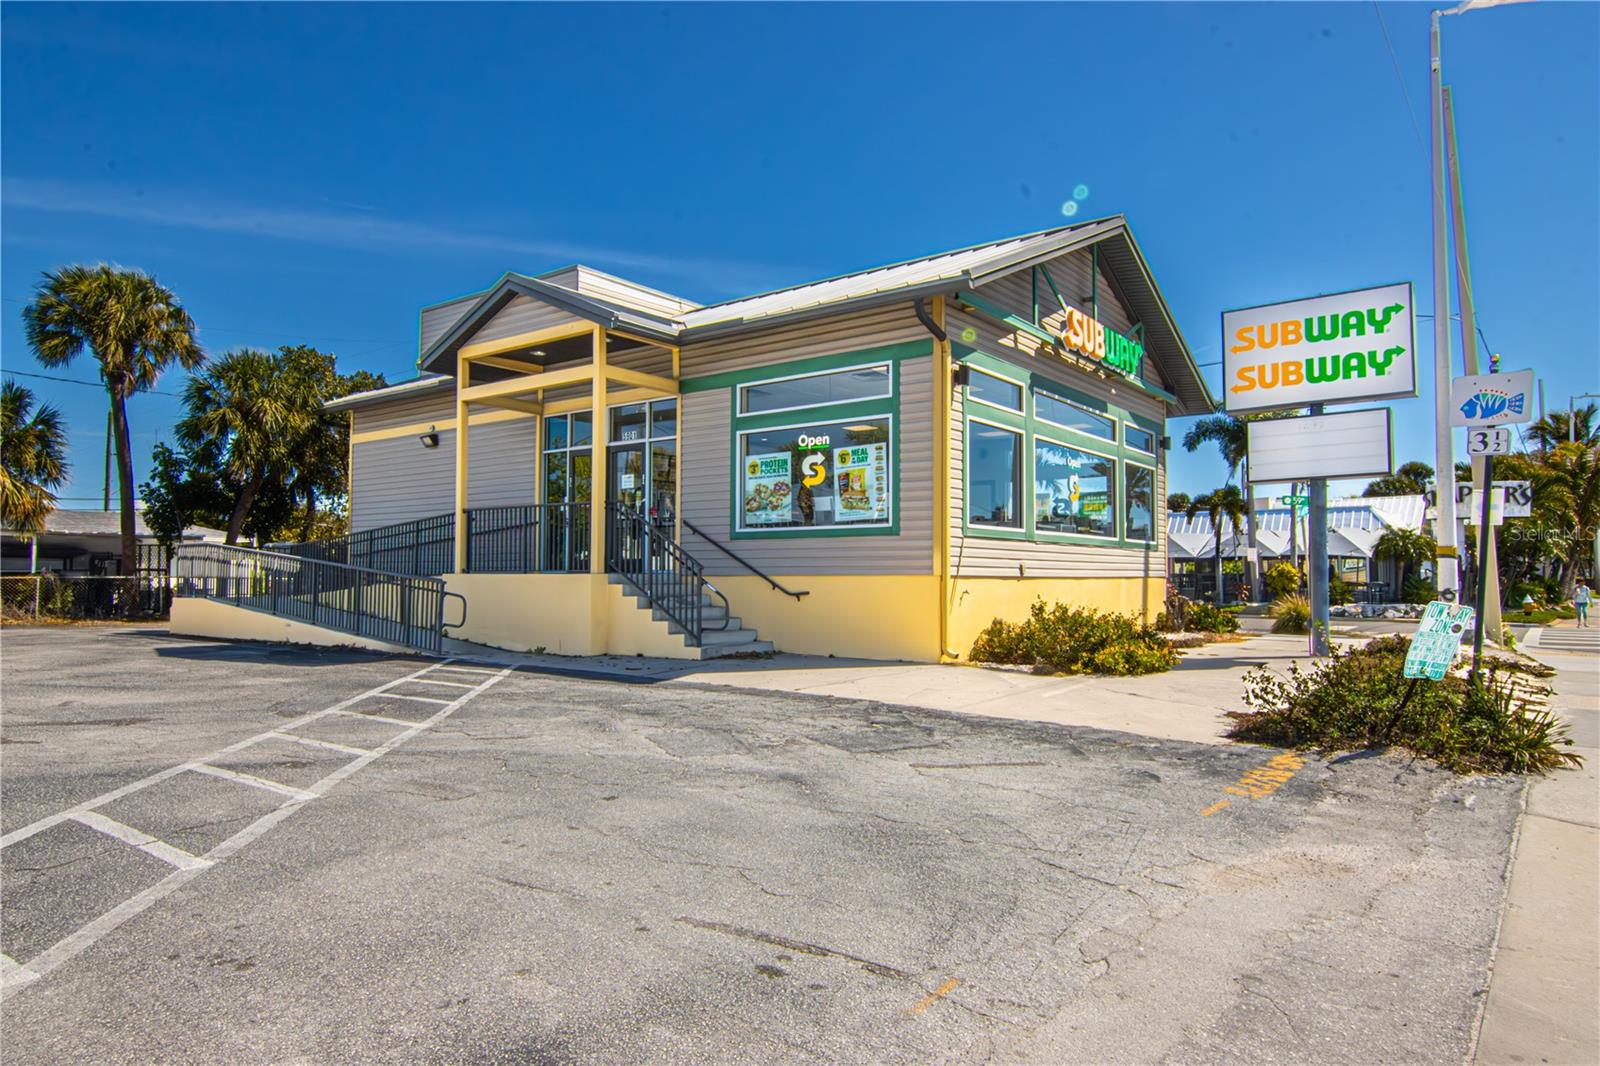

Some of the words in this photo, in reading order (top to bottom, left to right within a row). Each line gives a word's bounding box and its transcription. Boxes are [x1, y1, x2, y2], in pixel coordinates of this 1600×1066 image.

[1231, 302, 1405, 354] SUBWAY
[1064, 306, 1144, 375] SUBWAY
[1231, 345, 1407, 394] SUBWAY
[798, 433, 830, 449] Open
[851, 448, 868, 457] MEAL
[760, 459, 788, 469] PROTEIN
[1429, 618, 1455, 634] ZONE
